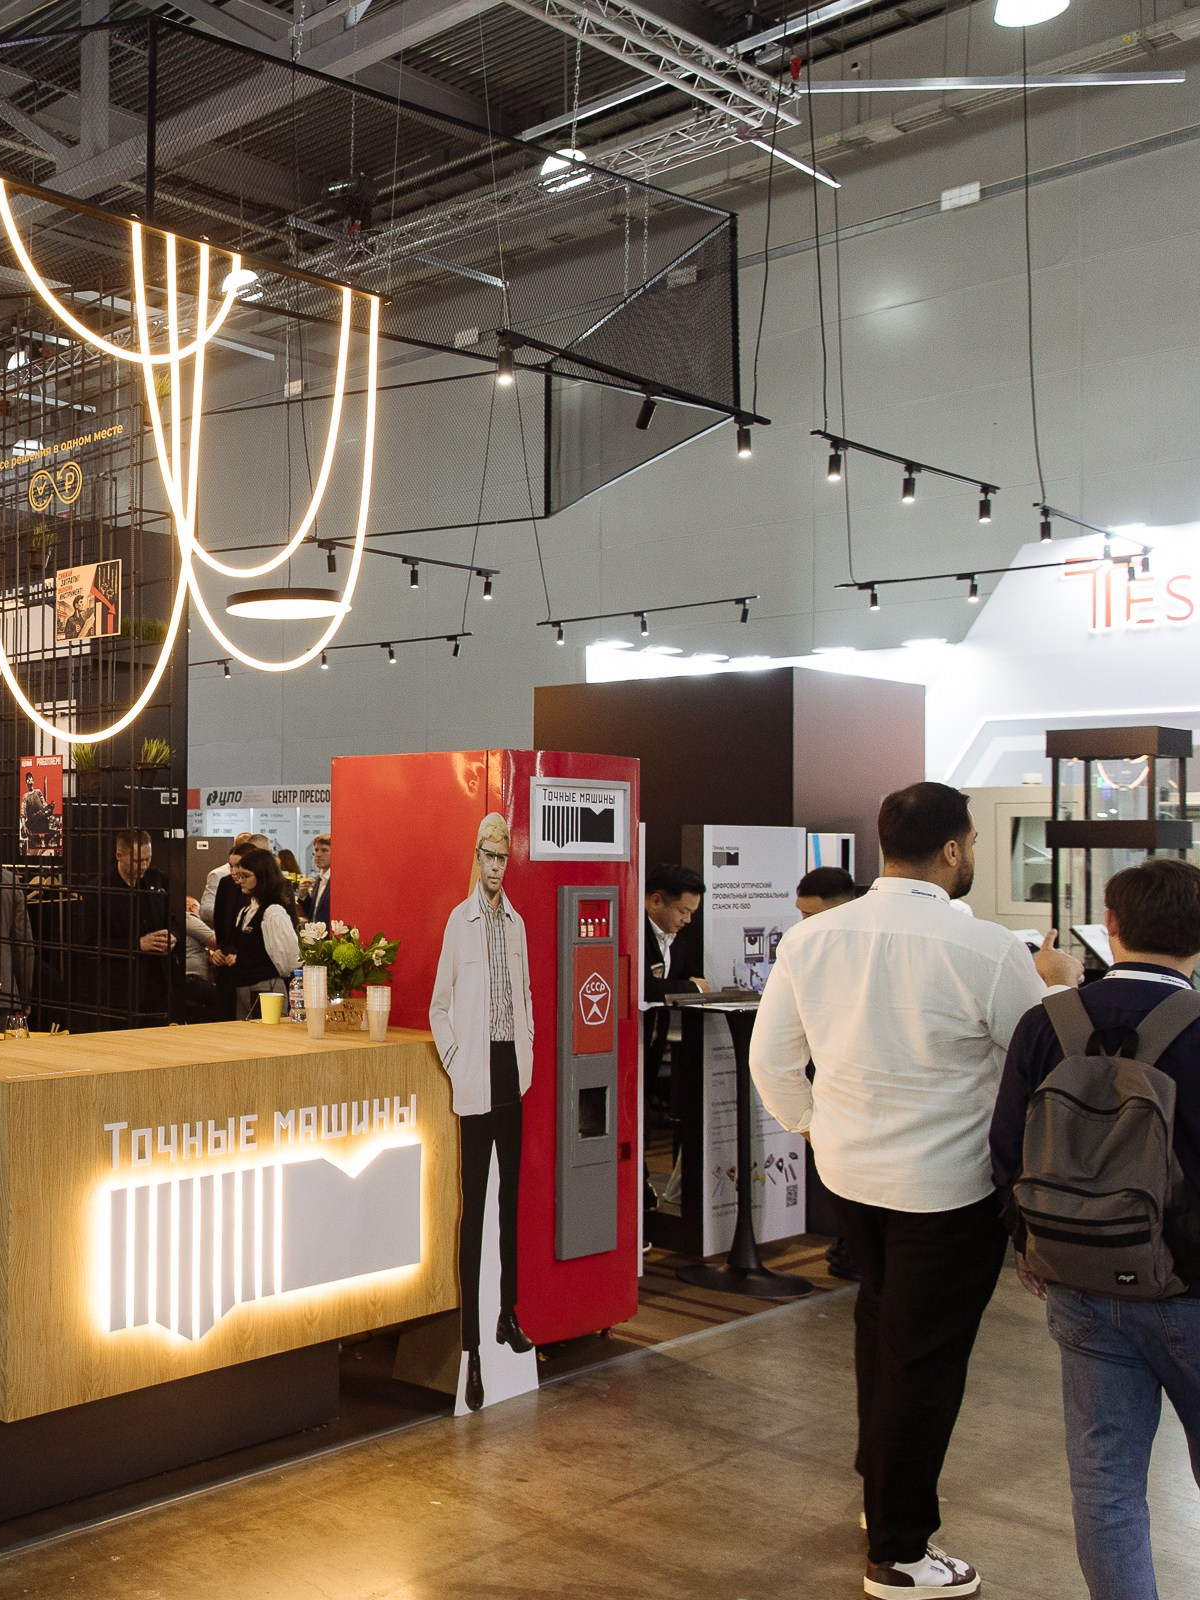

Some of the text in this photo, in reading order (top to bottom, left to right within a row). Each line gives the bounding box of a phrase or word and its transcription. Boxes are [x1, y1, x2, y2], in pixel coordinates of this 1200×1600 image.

[11, 446, 52, 469] решения
[53, 444, 59, 454] в
[61, 434, 91, 452] одном
[93, 424, 123, 442] месте
[272, 790, 298, 805] ЦЕНТР
[299, 789, 331, 803] ПРЕССО
[712, 903, 731, 911] СТАНОК
[585, 981, 606, 994] СССР
